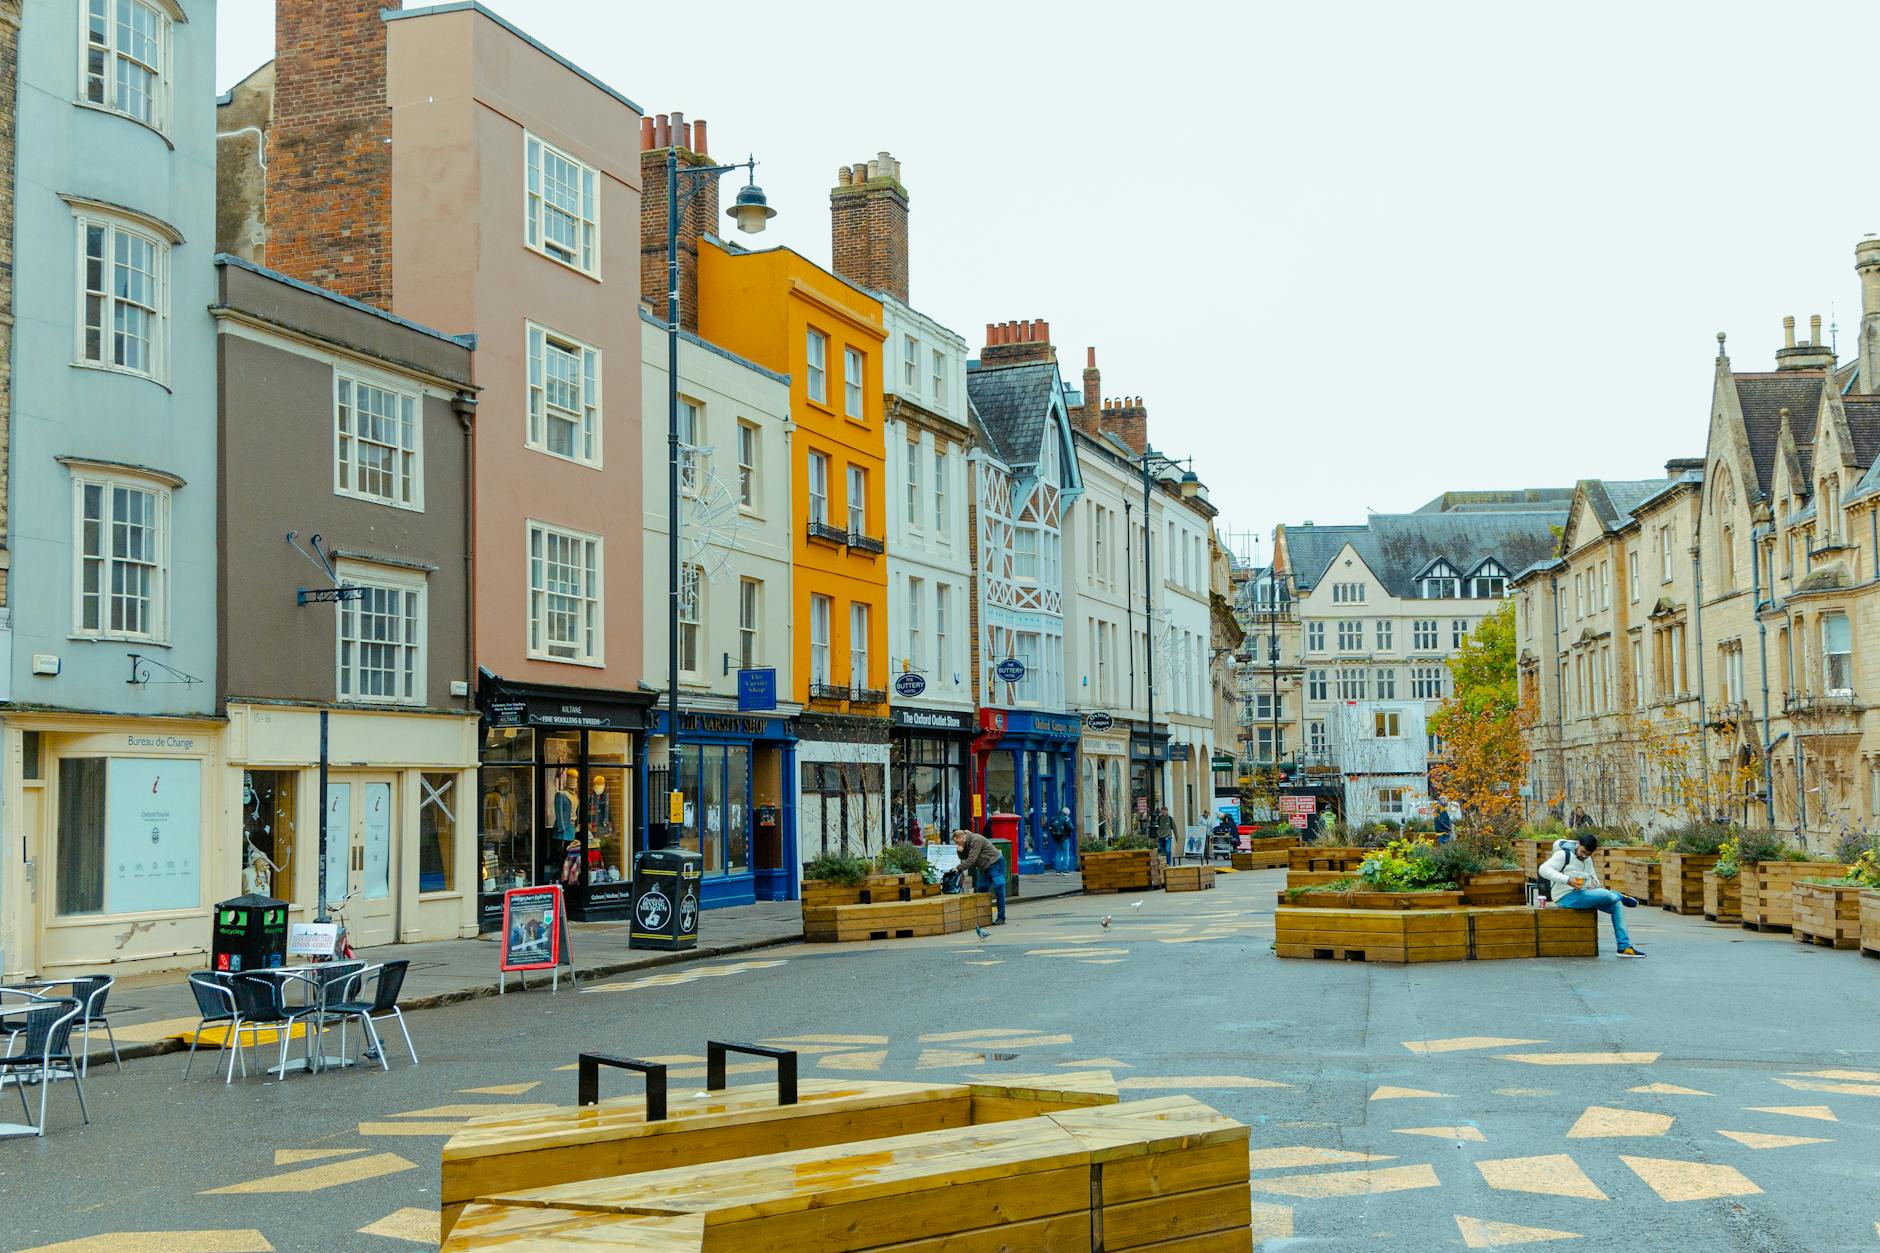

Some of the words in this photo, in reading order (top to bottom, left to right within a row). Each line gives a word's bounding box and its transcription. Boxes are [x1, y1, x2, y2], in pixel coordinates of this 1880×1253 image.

[561, 705, 582, 714] KILTANE
[542, 715, 553, 723] FINE
[553, 716, 578, 724] WOOLLENS
[582, 717, 601, 725] TWEEDS
[903, 712, 913, 724] The
[914, 713, 931, 725] Oxford
[932, 714, 947, 726] Outlet
[947, 716, 960, 727] Store
[1090, 712, 1109, 720] Oxford
[680, 715, 699, 730] THE
[702, 716, 742, 732] VARSITY
[743, 718, 768, 734] SHOP
[1035, 718, 1050, 731] Oxford
[128, 735, 154, 746] Bureau
[156, 736, 165, 747] de
[167, 736, 194, 749] Change
[219, 928, 246, 937] Recycling
